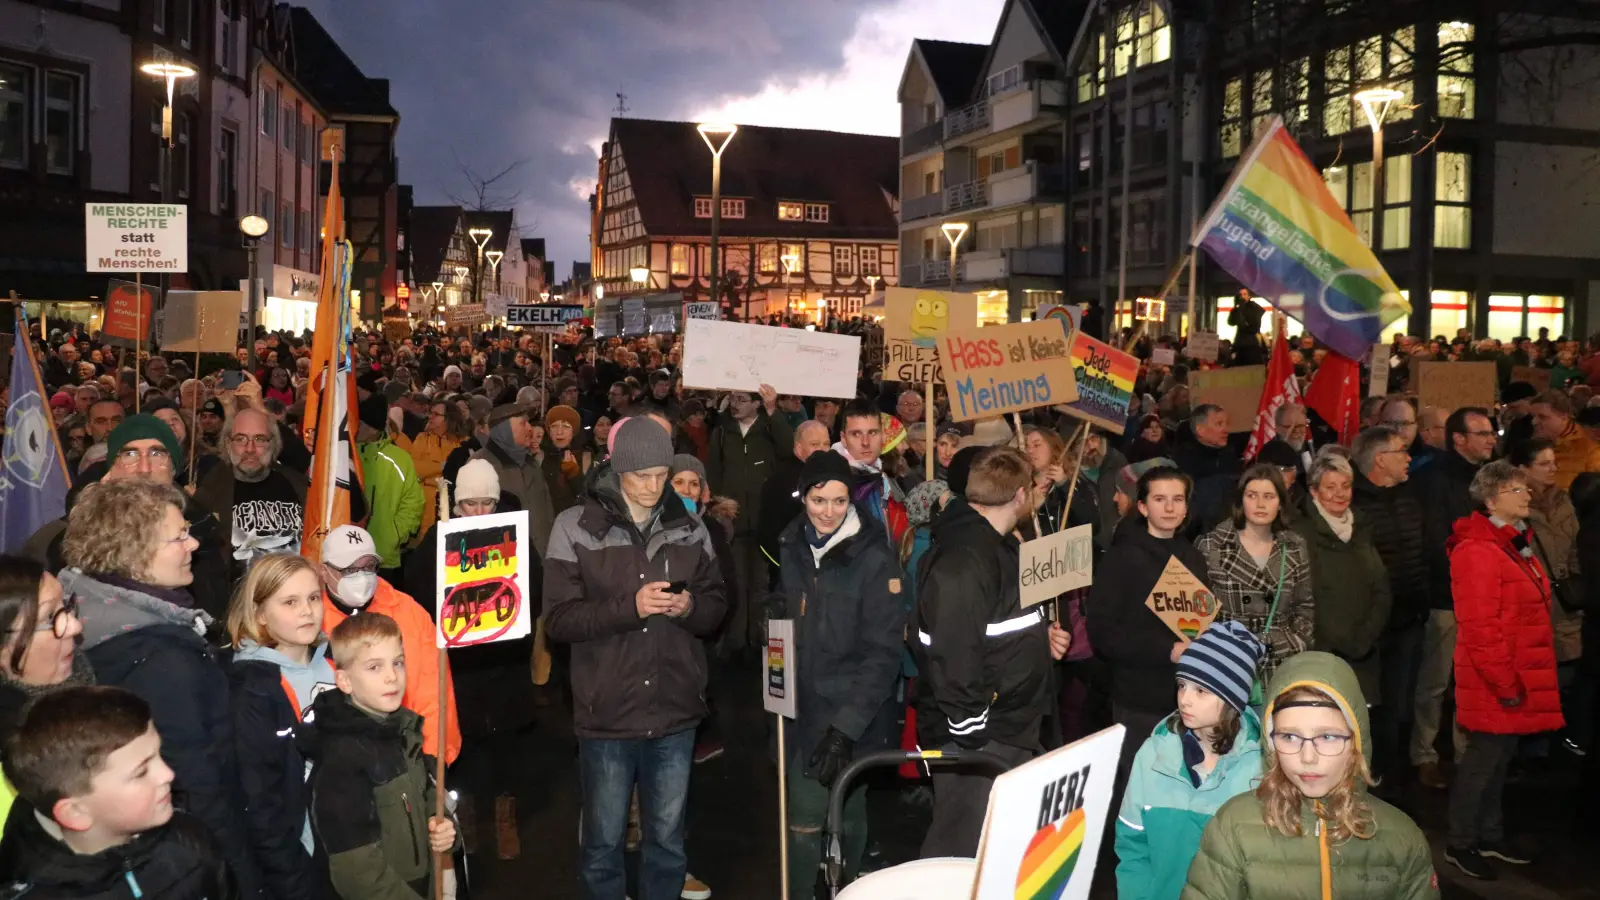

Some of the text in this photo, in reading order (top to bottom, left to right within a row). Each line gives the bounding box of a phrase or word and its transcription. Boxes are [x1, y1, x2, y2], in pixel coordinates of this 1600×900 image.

[92, 205, 183, 217] MENSCHEN-
[107, 218, 168, 229] RECHTE
[121, 232, 155, 243] statt
[1215, 212, 1277, 261] Jugend
[1229, 190, 1332, 280] Evangelische
[98, 258, 178, 269] Menschen!
[114, 247, 161, 258] rechte
[892, 344, 924, 362] ALLE
[946, 336, 1004, 373] Hass
[1007, 338, 1026, 364] ist
[1084, 344, 1112, 375] Jede
[898, 364, 946, 383] GLEIC
[955, 371, 1052, 417] Meinung
[460, 531, 510, 573] bunt
[1036, 763, 1092, 832] HERZ
